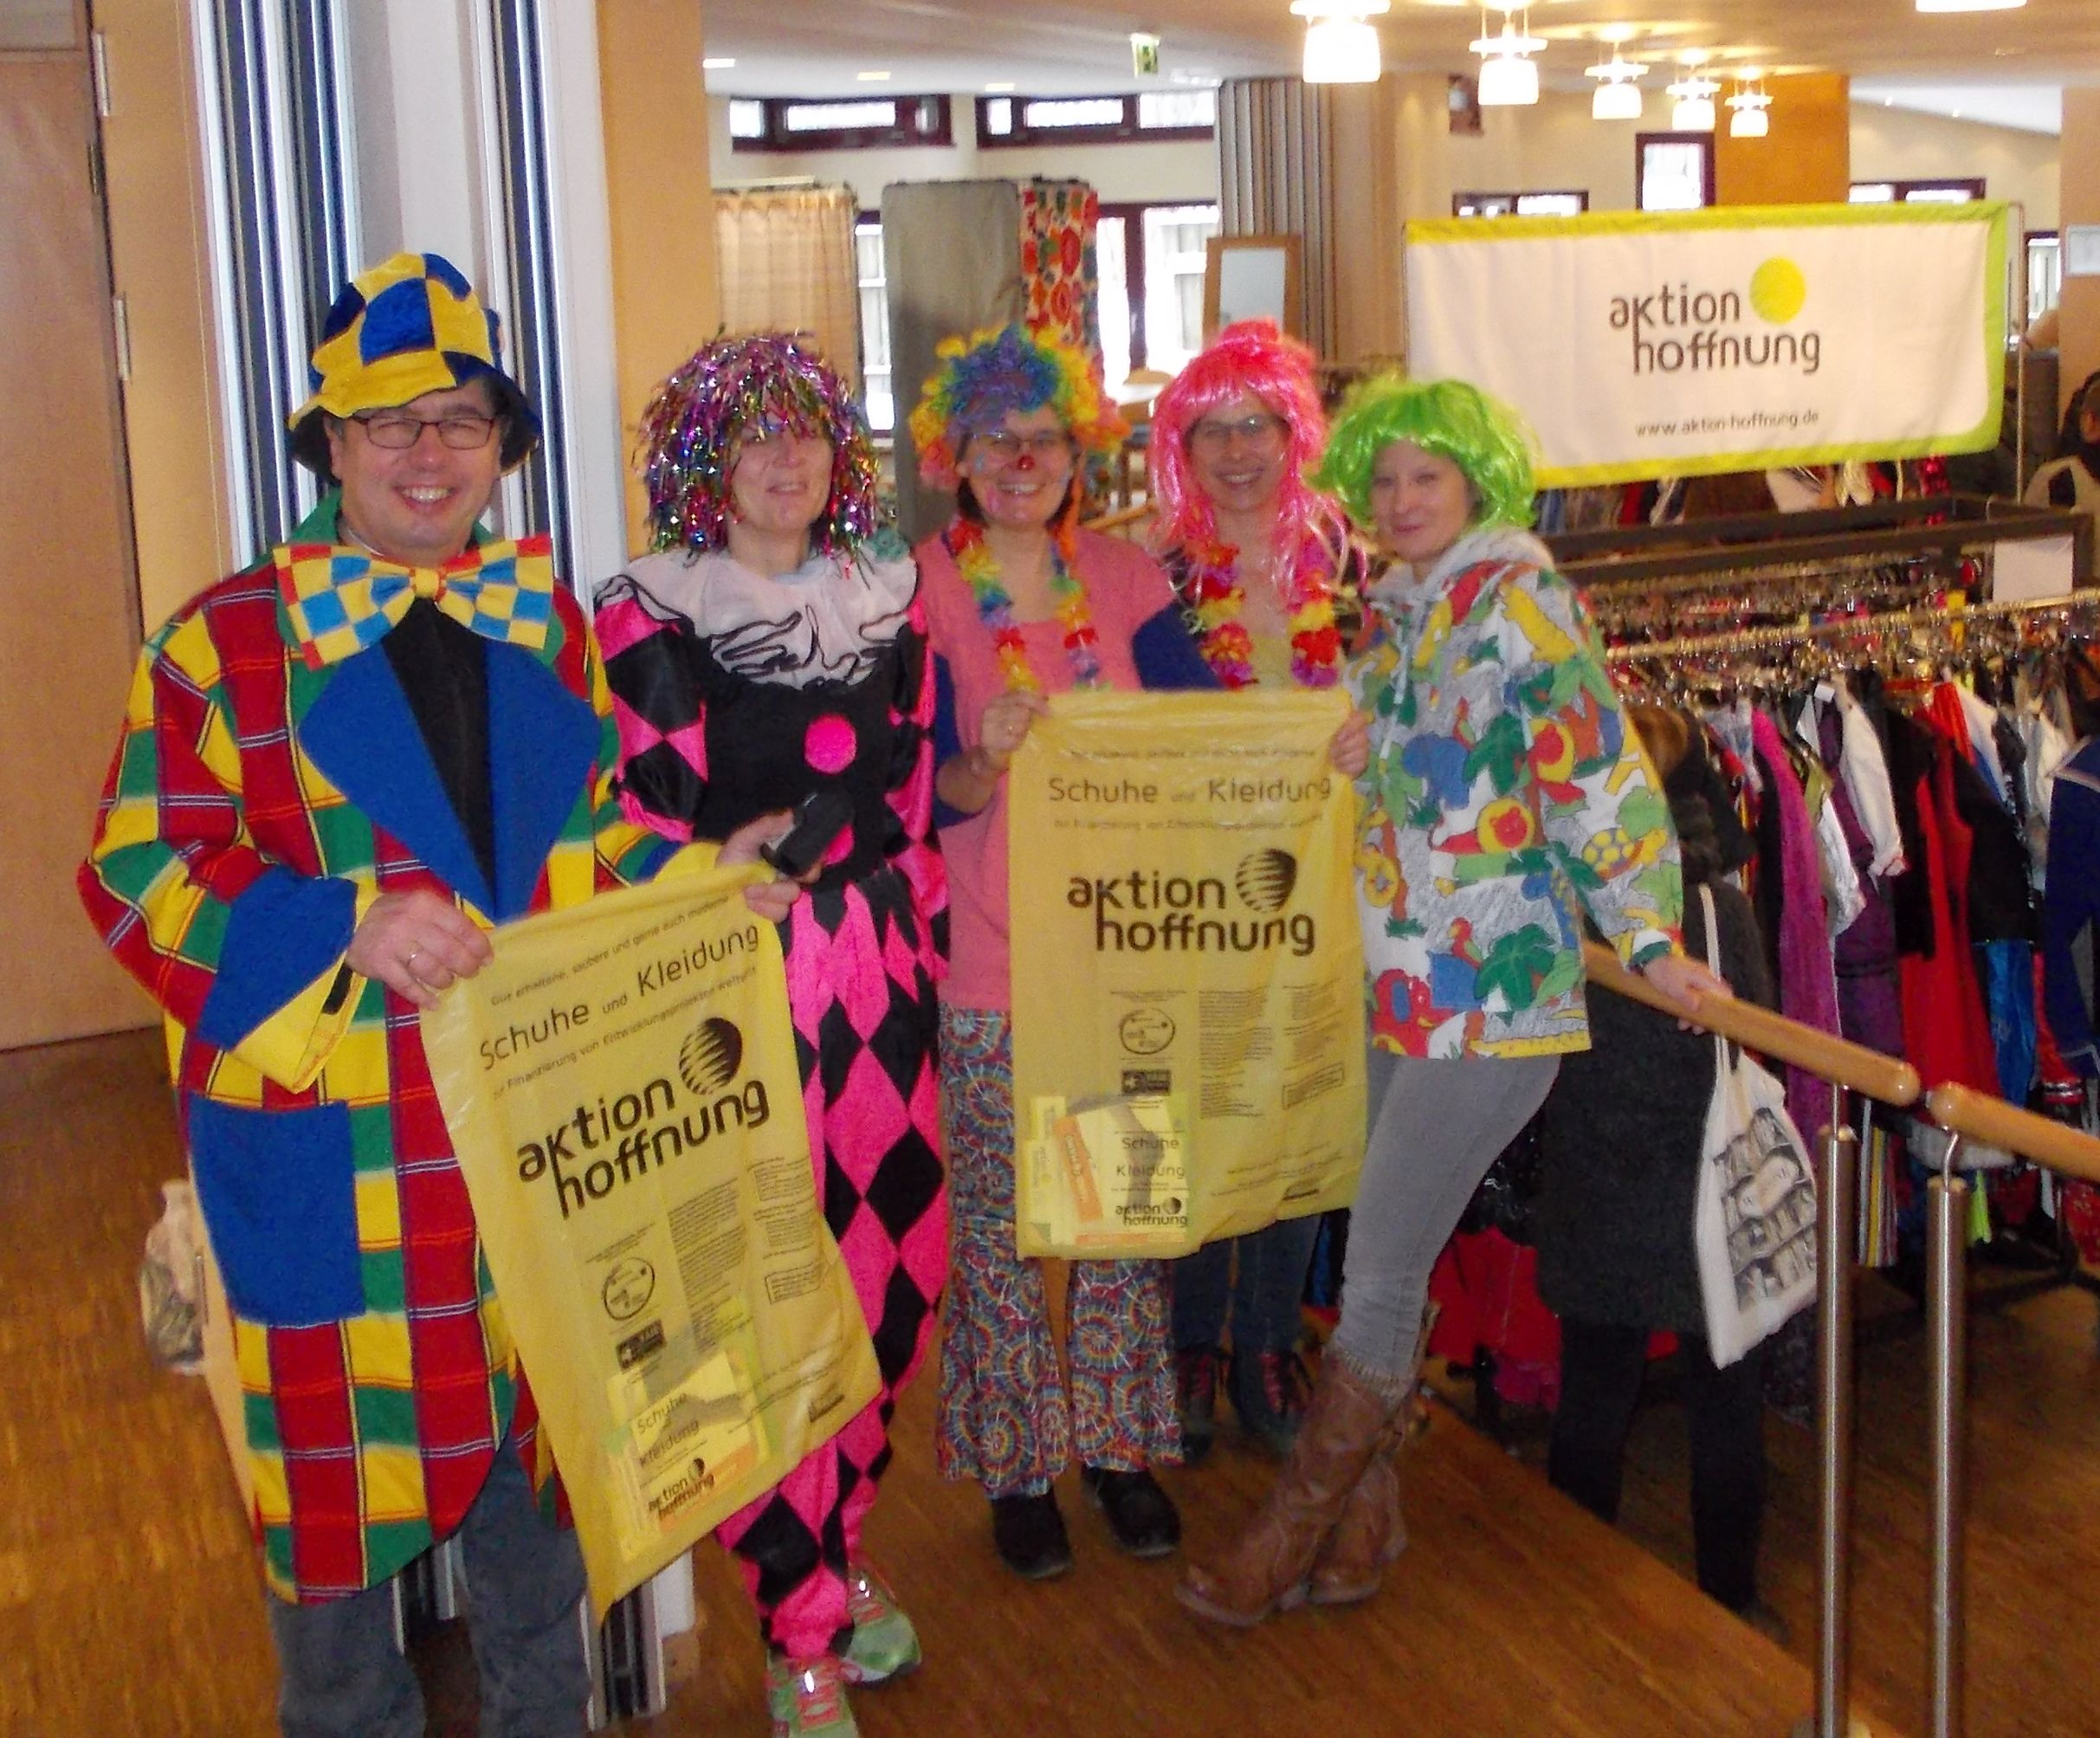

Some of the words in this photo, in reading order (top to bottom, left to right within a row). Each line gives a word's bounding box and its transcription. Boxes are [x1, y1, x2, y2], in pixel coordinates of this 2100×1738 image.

[1608, 282, 1741, 331] aktion
[1632, 329, 1820, 375] hoffnung
[1636, 409, 1819, 438] www.aktion-hoffnung.de
[1047, 778, 1158, 803] Schuhe
[1206, 774, 1333, 804] Kleidung
[1066, 870, 1226, 910] aktion
[1095, 912, 1315, 957] hoffnung
[480, 1003, 591, 1071] Schuhe
[601, 993, 629, 1014] und
[636, 924, 759, 997] Kleidung
[578, 1040, 600, 1056] von
[516, 1076, 676, 1183] aktion
[554, 1079, 771, 1218] hoffnung
[1121, 1136, 1180, 1149] Schuhe
[1116, 1165, 1186, 1179] Kleidung
[1123, 1213, 1188, 1228] hoffnung
